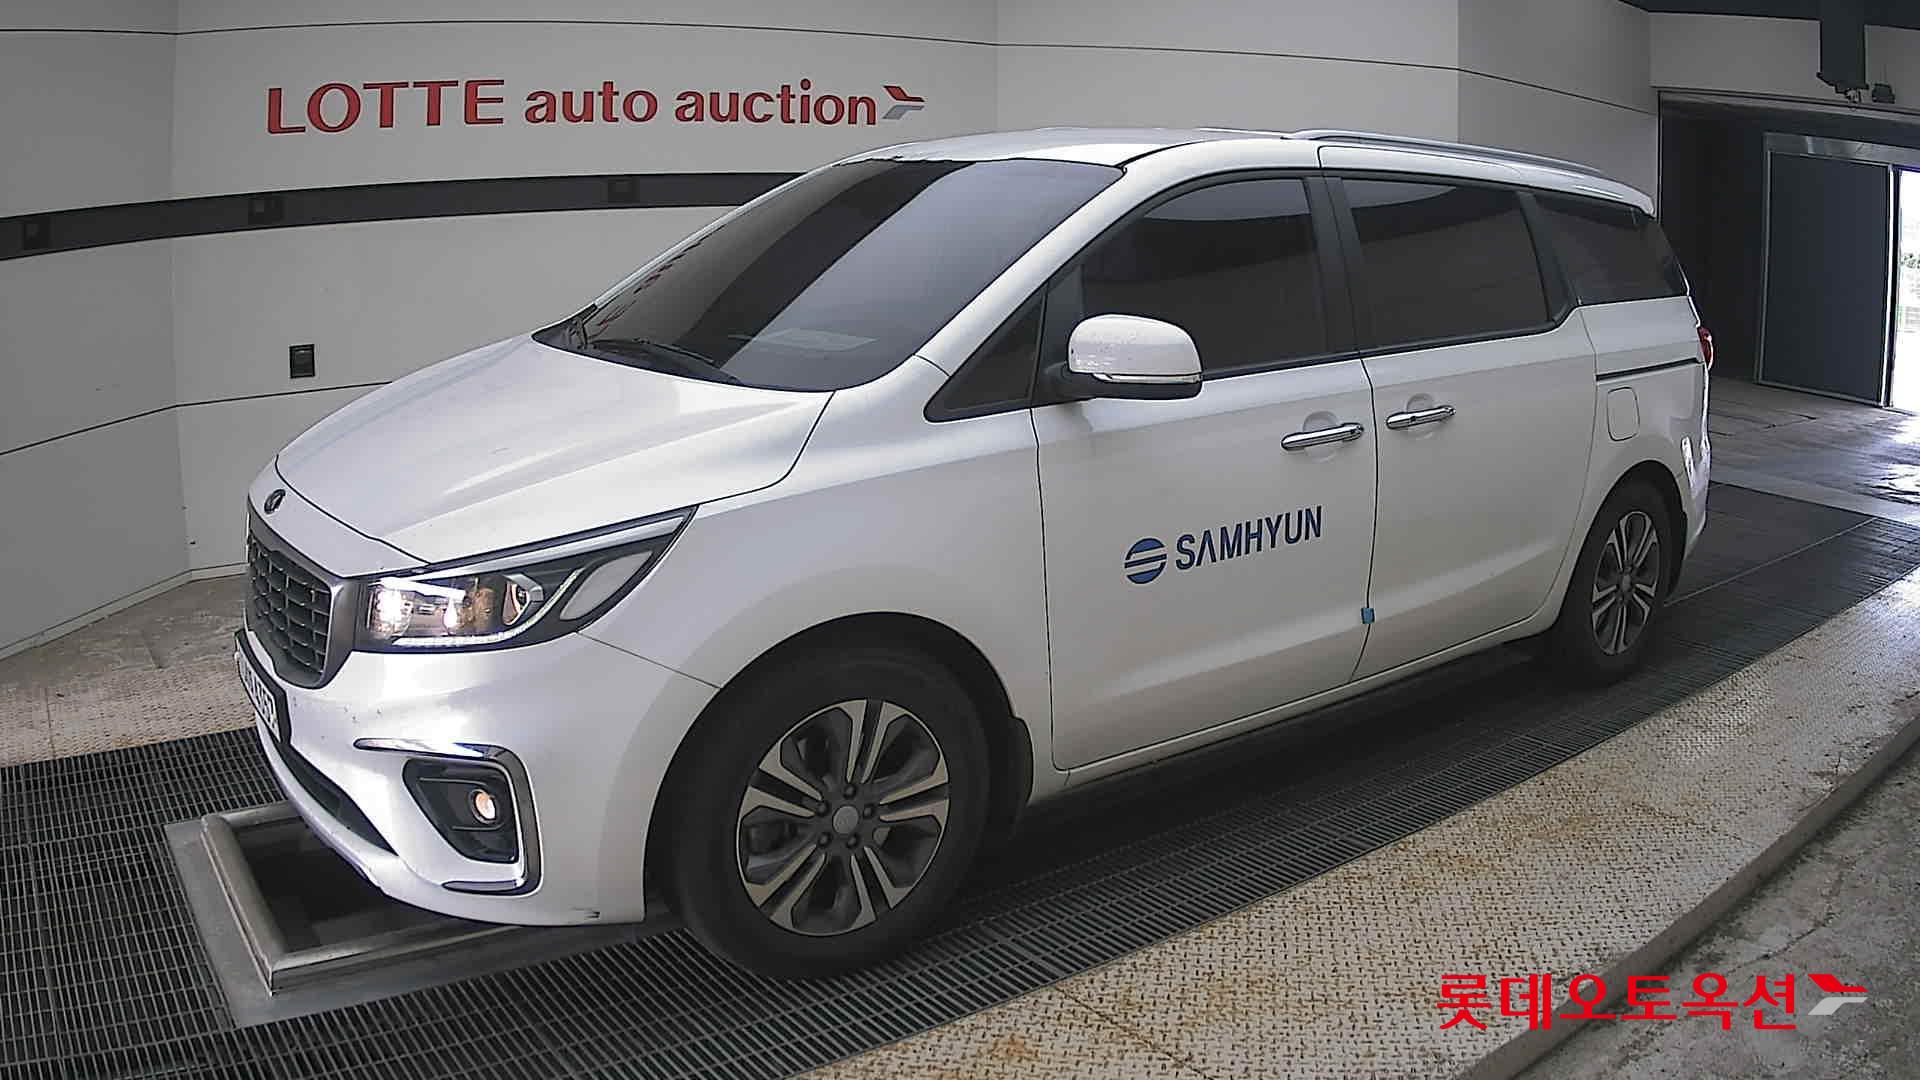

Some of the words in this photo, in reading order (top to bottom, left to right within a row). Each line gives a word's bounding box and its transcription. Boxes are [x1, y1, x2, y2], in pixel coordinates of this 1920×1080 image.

[267, 80, 505, 134] LOTTE
[525, 81, 658, 125] auto
[675, 80, 877, 125] auction
[1175, 505, 1322, 571] SAMHYUN
